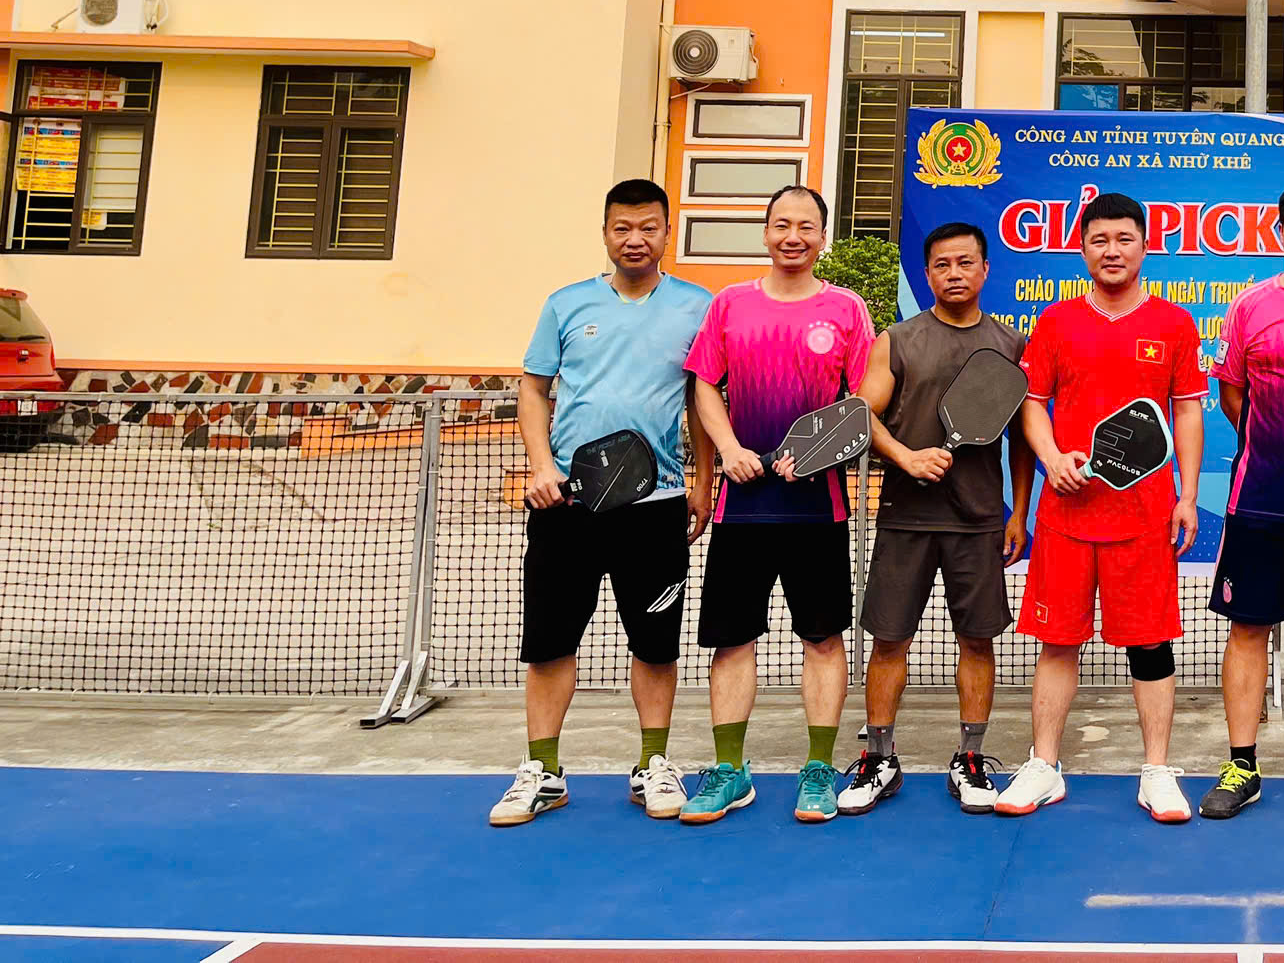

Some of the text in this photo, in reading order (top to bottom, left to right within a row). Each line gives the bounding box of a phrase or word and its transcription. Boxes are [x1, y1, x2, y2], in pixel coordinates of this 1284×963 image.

[1014, 125, 1066, 144] CÔNG
[1071, 130, 1098, 144] AN
[1102, 125, 1149, 145] TỈNH
[1153, 128, 1216, 146] TUYÊN
[1049, 150, 1101, 168] CÔNG
[1105, 154, 1132, 168] AN
[1137, 152, 1164, 169] XÃ
[1212, 152, 1253, 170] KHÊ
[998, 183, 1099, 254] GIẢ
[1015, 274, 1055, 302] CHÀO
[1058, 275, 1095, 302] MỪN
[1141, 276, 1164, 299] ĂM
[1167, 276, 1207, 304] NGÀY
